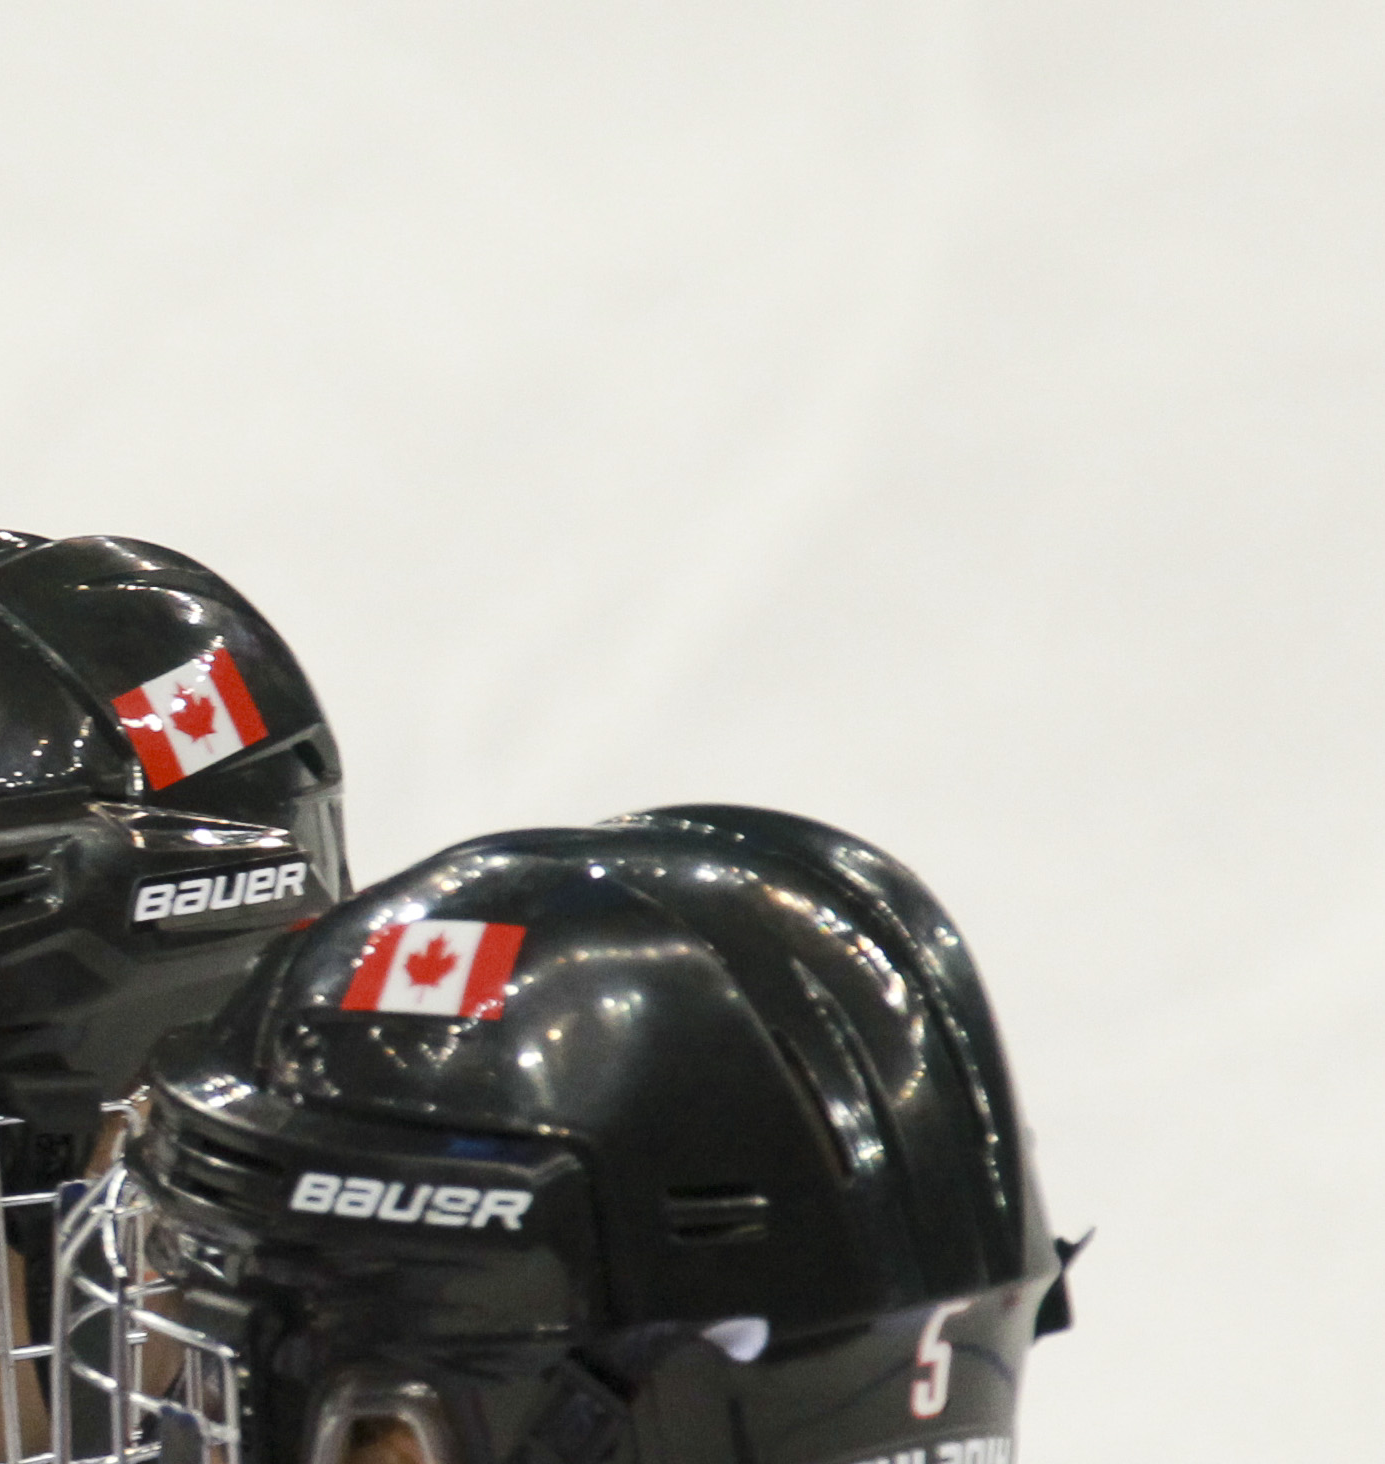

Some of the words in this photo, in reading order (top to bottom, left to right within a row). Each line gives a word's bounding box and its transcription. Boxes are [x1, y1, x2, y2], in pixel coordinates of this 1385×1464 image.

[134, 862, 307, 923] BAUER
[290, 1171, 533, 1230] BAUER
[910, 1300, 973, 1419] 5
